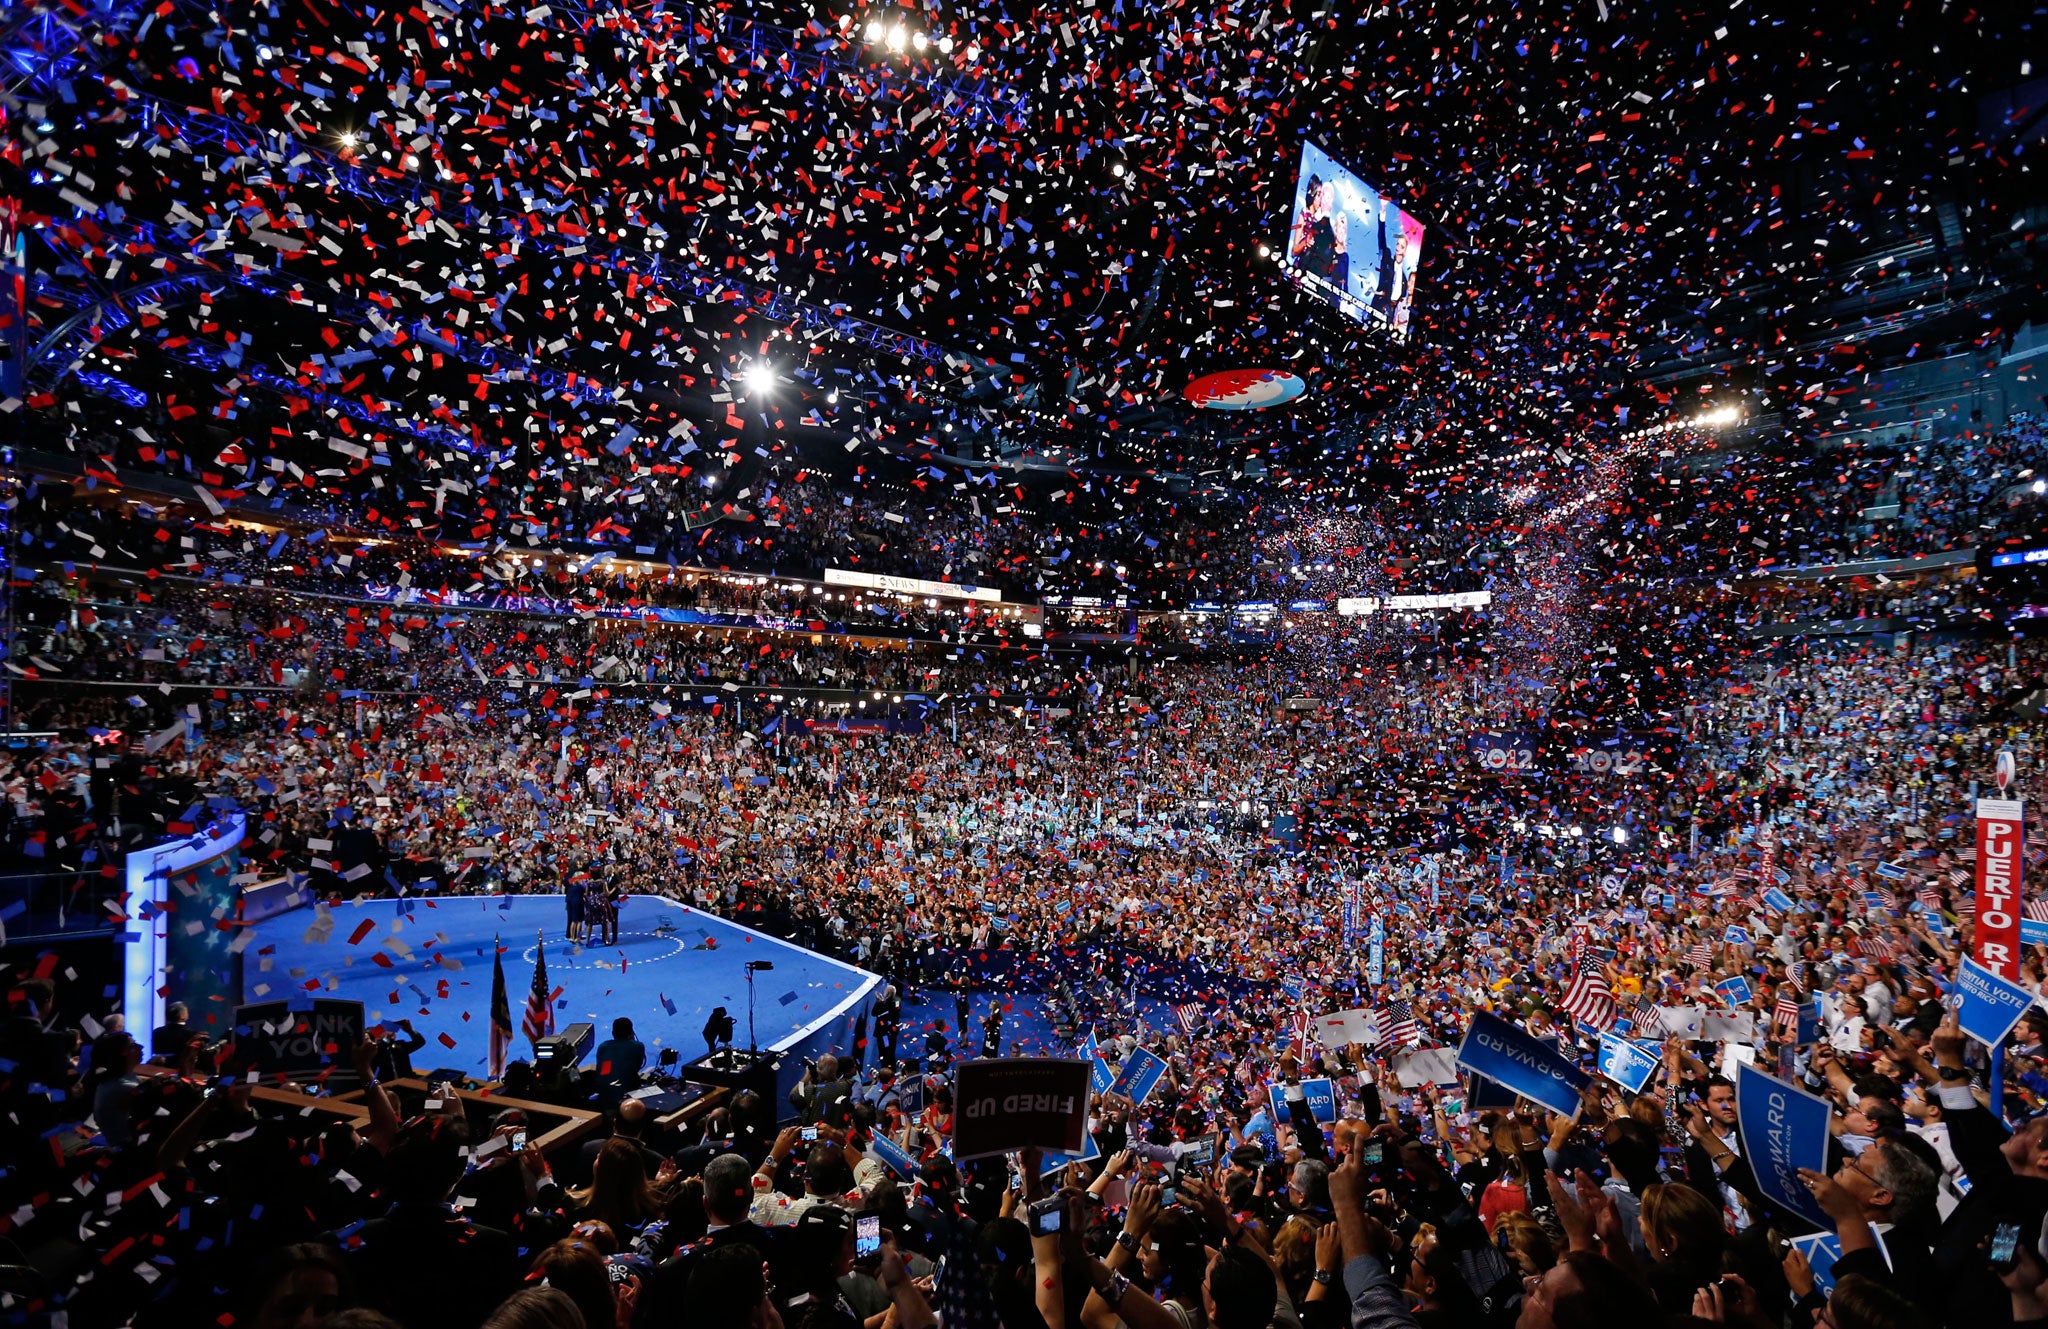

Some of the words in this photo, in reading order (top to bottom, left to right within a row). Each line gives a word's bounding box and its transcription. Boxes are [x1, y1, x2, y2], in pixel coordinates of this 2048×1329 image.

[887, 577, 915, 590] NEWS
[1573, 750, 1644, 773] 2012
[1982, 822, 2013, 929] PUERTO
[1983, 942, 2011, 979] RI
[1977, 990, 1997, 1005] RICO
[1992, 985, 2025, 1010] VOTE
[268, 1036, 339, 1059] YOU
[1634, 1054, 1653, 1070] VOTE
[965, 1096, 996, 1118] UP
[1002, 1094, 1074, 1114] FIRED
[1277, 1094, 1330, 1110] FOARD
